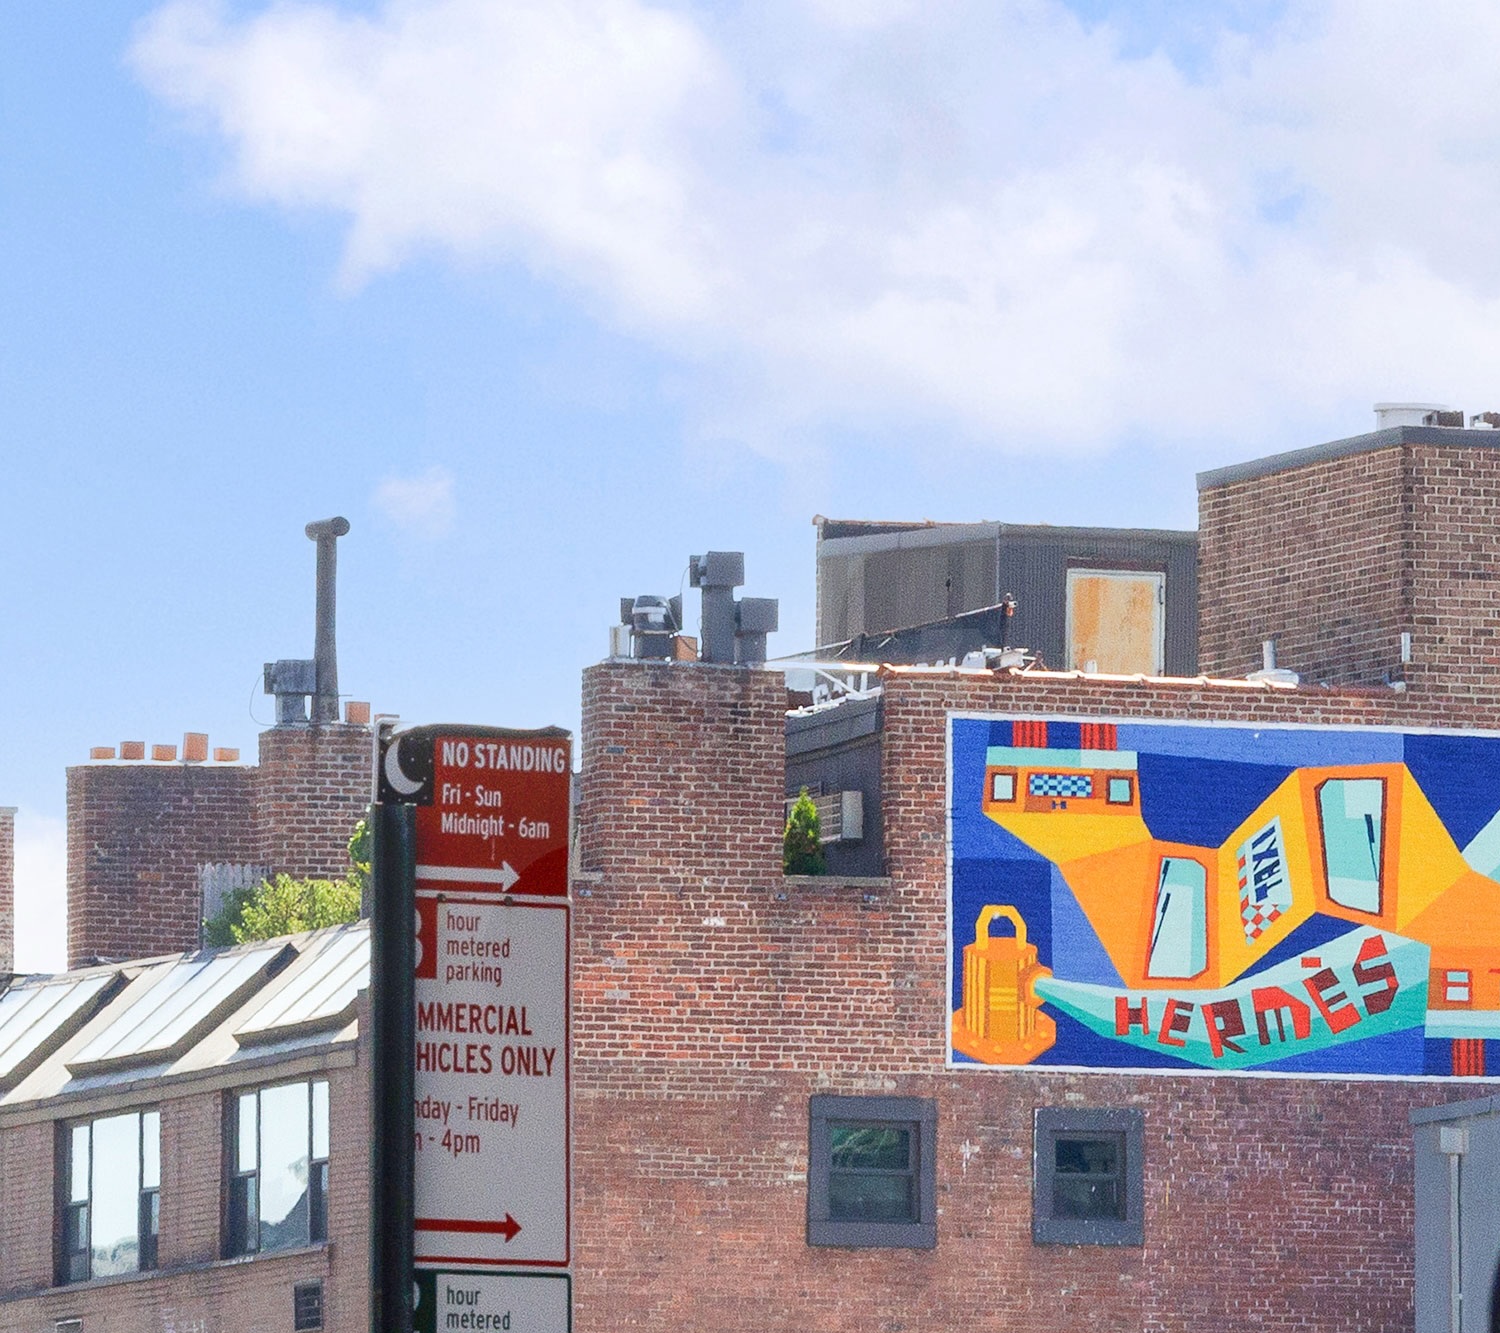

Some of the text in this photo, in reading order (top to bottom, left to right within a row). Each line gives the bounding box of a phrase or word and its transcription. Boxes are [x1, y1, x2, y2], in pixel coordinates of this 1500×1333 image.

[443, 741, 565, 773] NO STANDING
[442, 783, 461, 804] Fri
[475, 785, 502, 807] Sun
[441, 812, 505, 840] Midnight
[519, 816, 550, 839] 6am
[1252, 825, 1283, 903] TAXI
[446, 911, 481, 931] hour
[446, 937, 511, 958] metered
[446, 961, 502, 987] parking
[1114, 934, 1400, 1058] HERMÈS
[417, 1001, 533, 1036] MMERCIAL
[416, 1042, 557, 1077] HICLES ONLY
[414, 1095, 451, 1125] nday
[467, 1096, 519, 1129] Friday
[442, 1128, 480, 1157] 4pm
[446, 1285, 481, 1305] hour
[446, 1310, 511, 1330] metered
